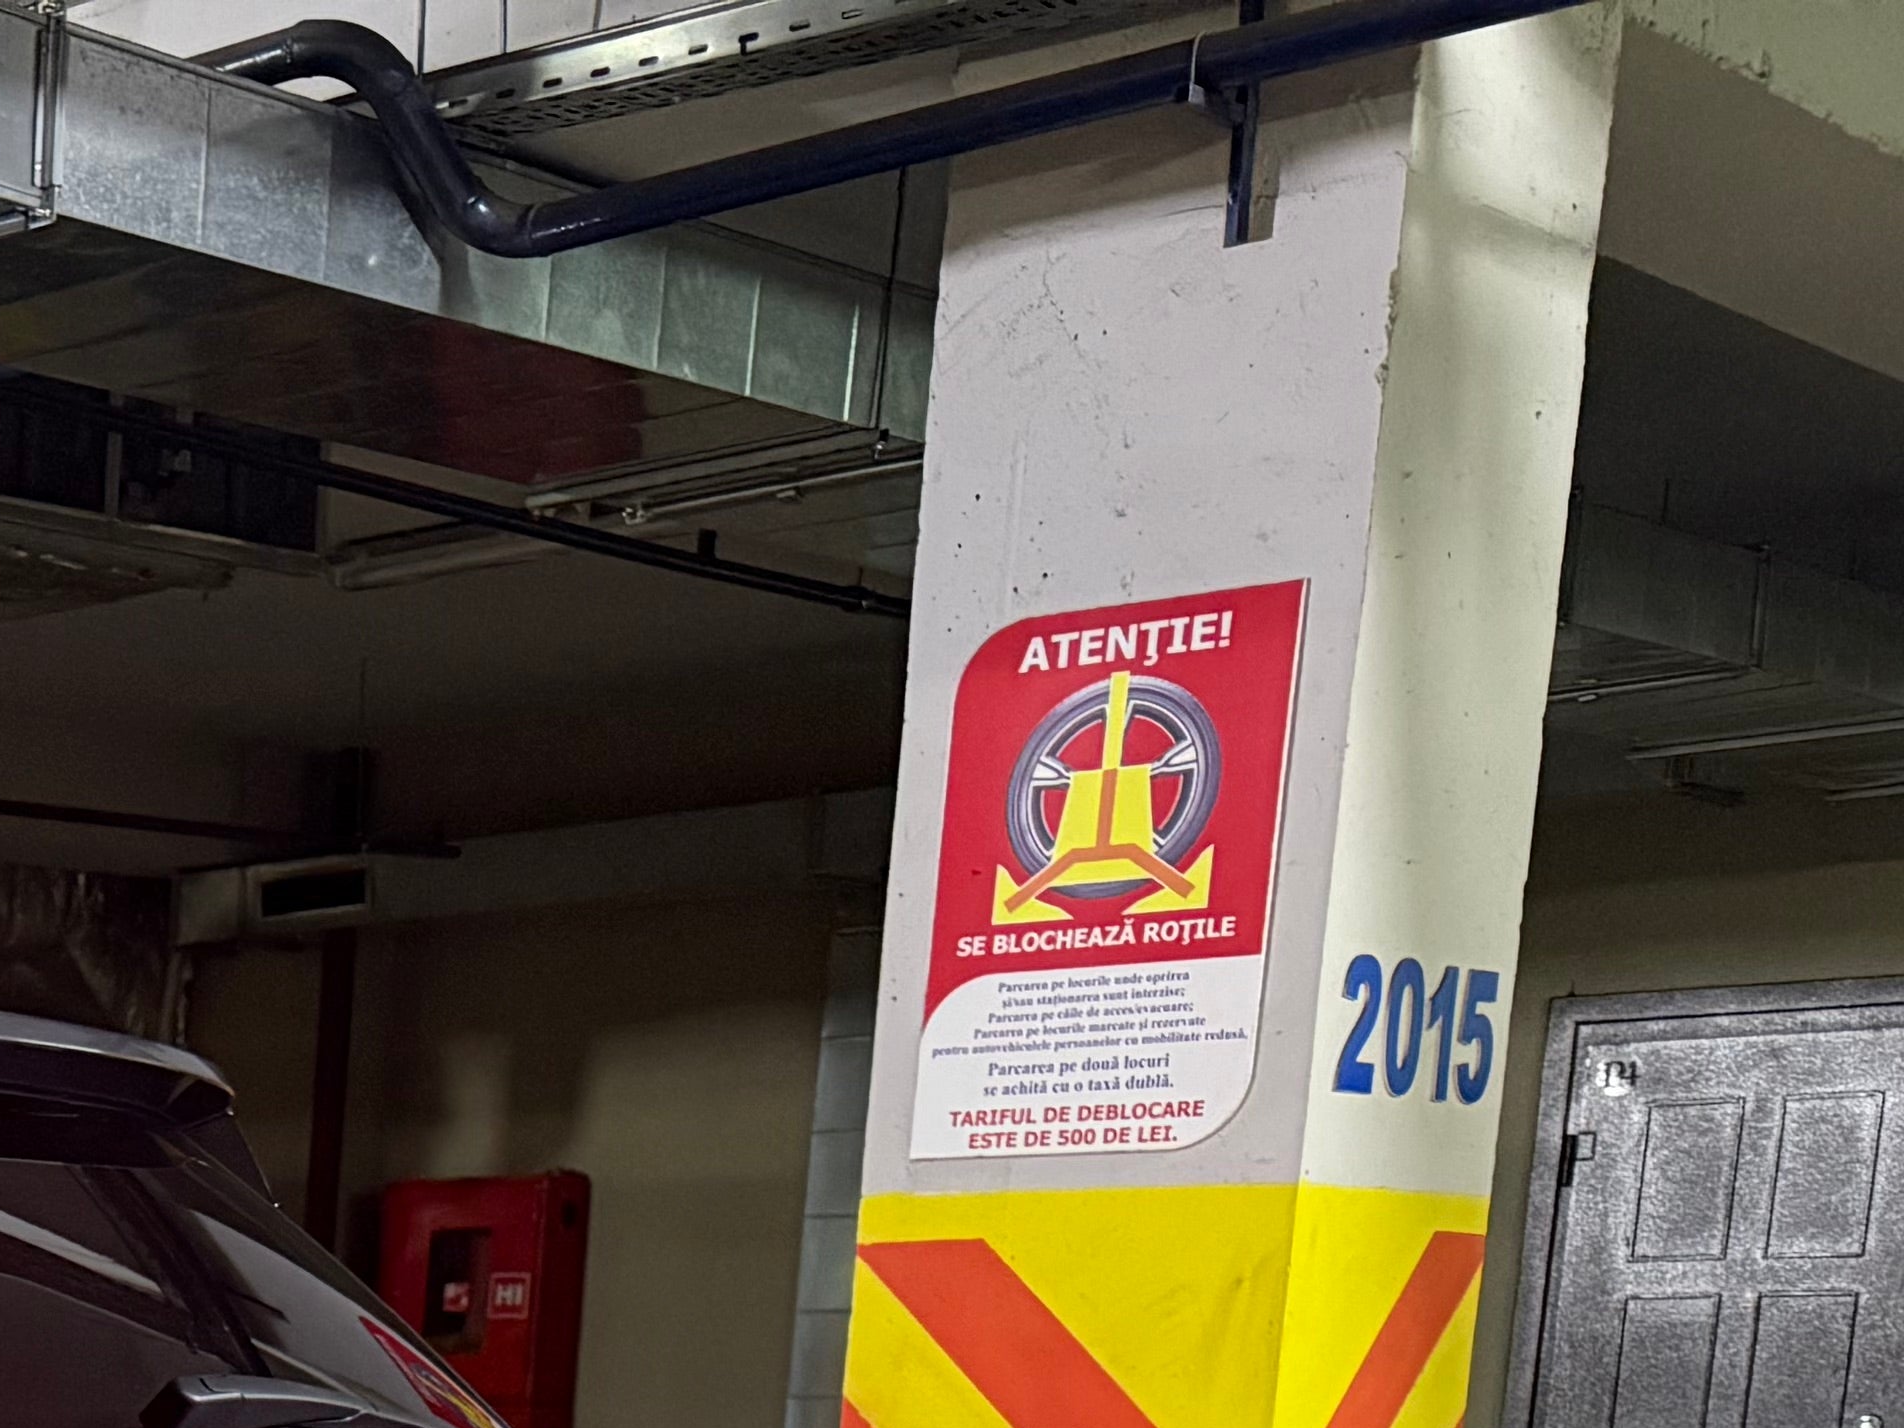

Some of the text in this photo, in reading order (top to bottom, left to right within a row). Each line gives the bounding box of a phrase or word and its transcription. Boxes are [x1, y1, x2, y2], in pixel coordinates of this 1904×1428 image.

[956, 936, 987, 958] SE
[992, 917, 1136, 955] BLOCHEAZĂ
[1051, 979, 1065, 992] pe
[1041, 1011, 1054, 1023] pe
[1086, 1006, 1100, 1018] de
[1026, 1026, 1040, 1038] pe
[1333, 954, 1499, 1106] 2015
[988, 1053, 1170, 1077] Parcarea pe două locuri
[983, 1074, 1174, 1096] se achită cu o taxă dublă.
[949, 1100, 1205, 1127] TARIFUL DE DEBLOCARE
[968, 1125, 1178, 1149] ESTE DE 500 DE LEI.
